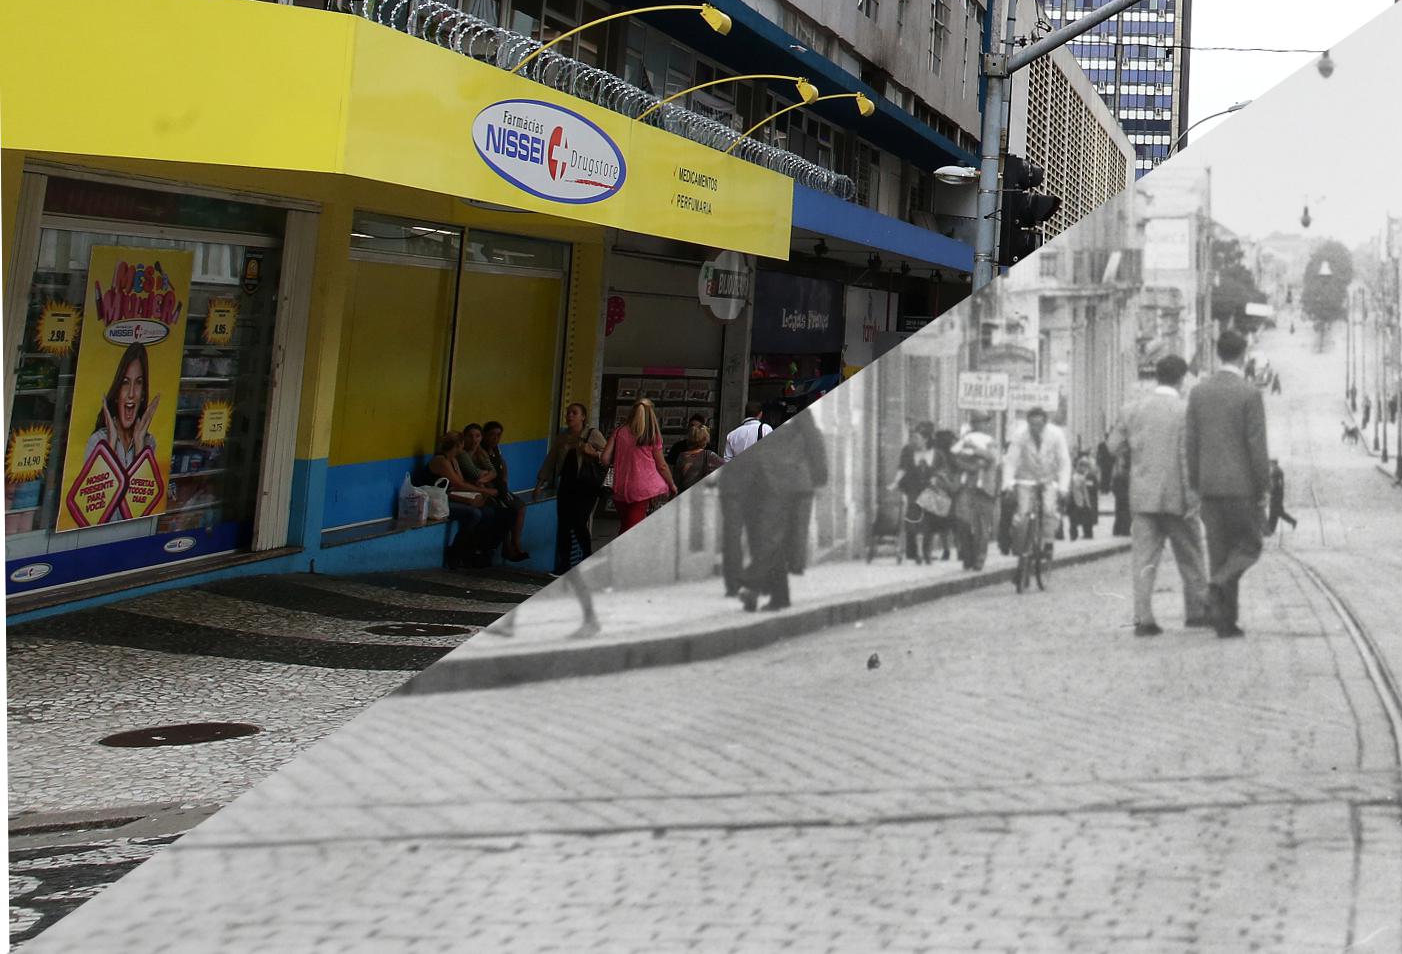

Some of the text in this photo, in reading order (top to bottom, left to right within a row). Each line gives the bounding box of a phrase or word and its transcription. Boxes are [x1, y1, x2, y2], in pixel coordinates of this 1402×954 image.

[503, 110, 544, 135] Farmácias
[486, 123, 545, 165] NISSEI
[571, 150, 619, 180] Drugstore
[678, 166, 718, 192] MEDICAMENTOS
[676, 194, 713, 215] PERFUMARIA
[112, 260, 156, 295] MÊS
[103, 290, 177, 326] MULHER
[109, 329, 133, 337] NISSEI
[80, 479, 115, 496] PRESENTE
[86, 472, 110, 486] NOSSO
[130, 478, 155, 488] OFERTAS
[87, 492, 106, 503] PARA
